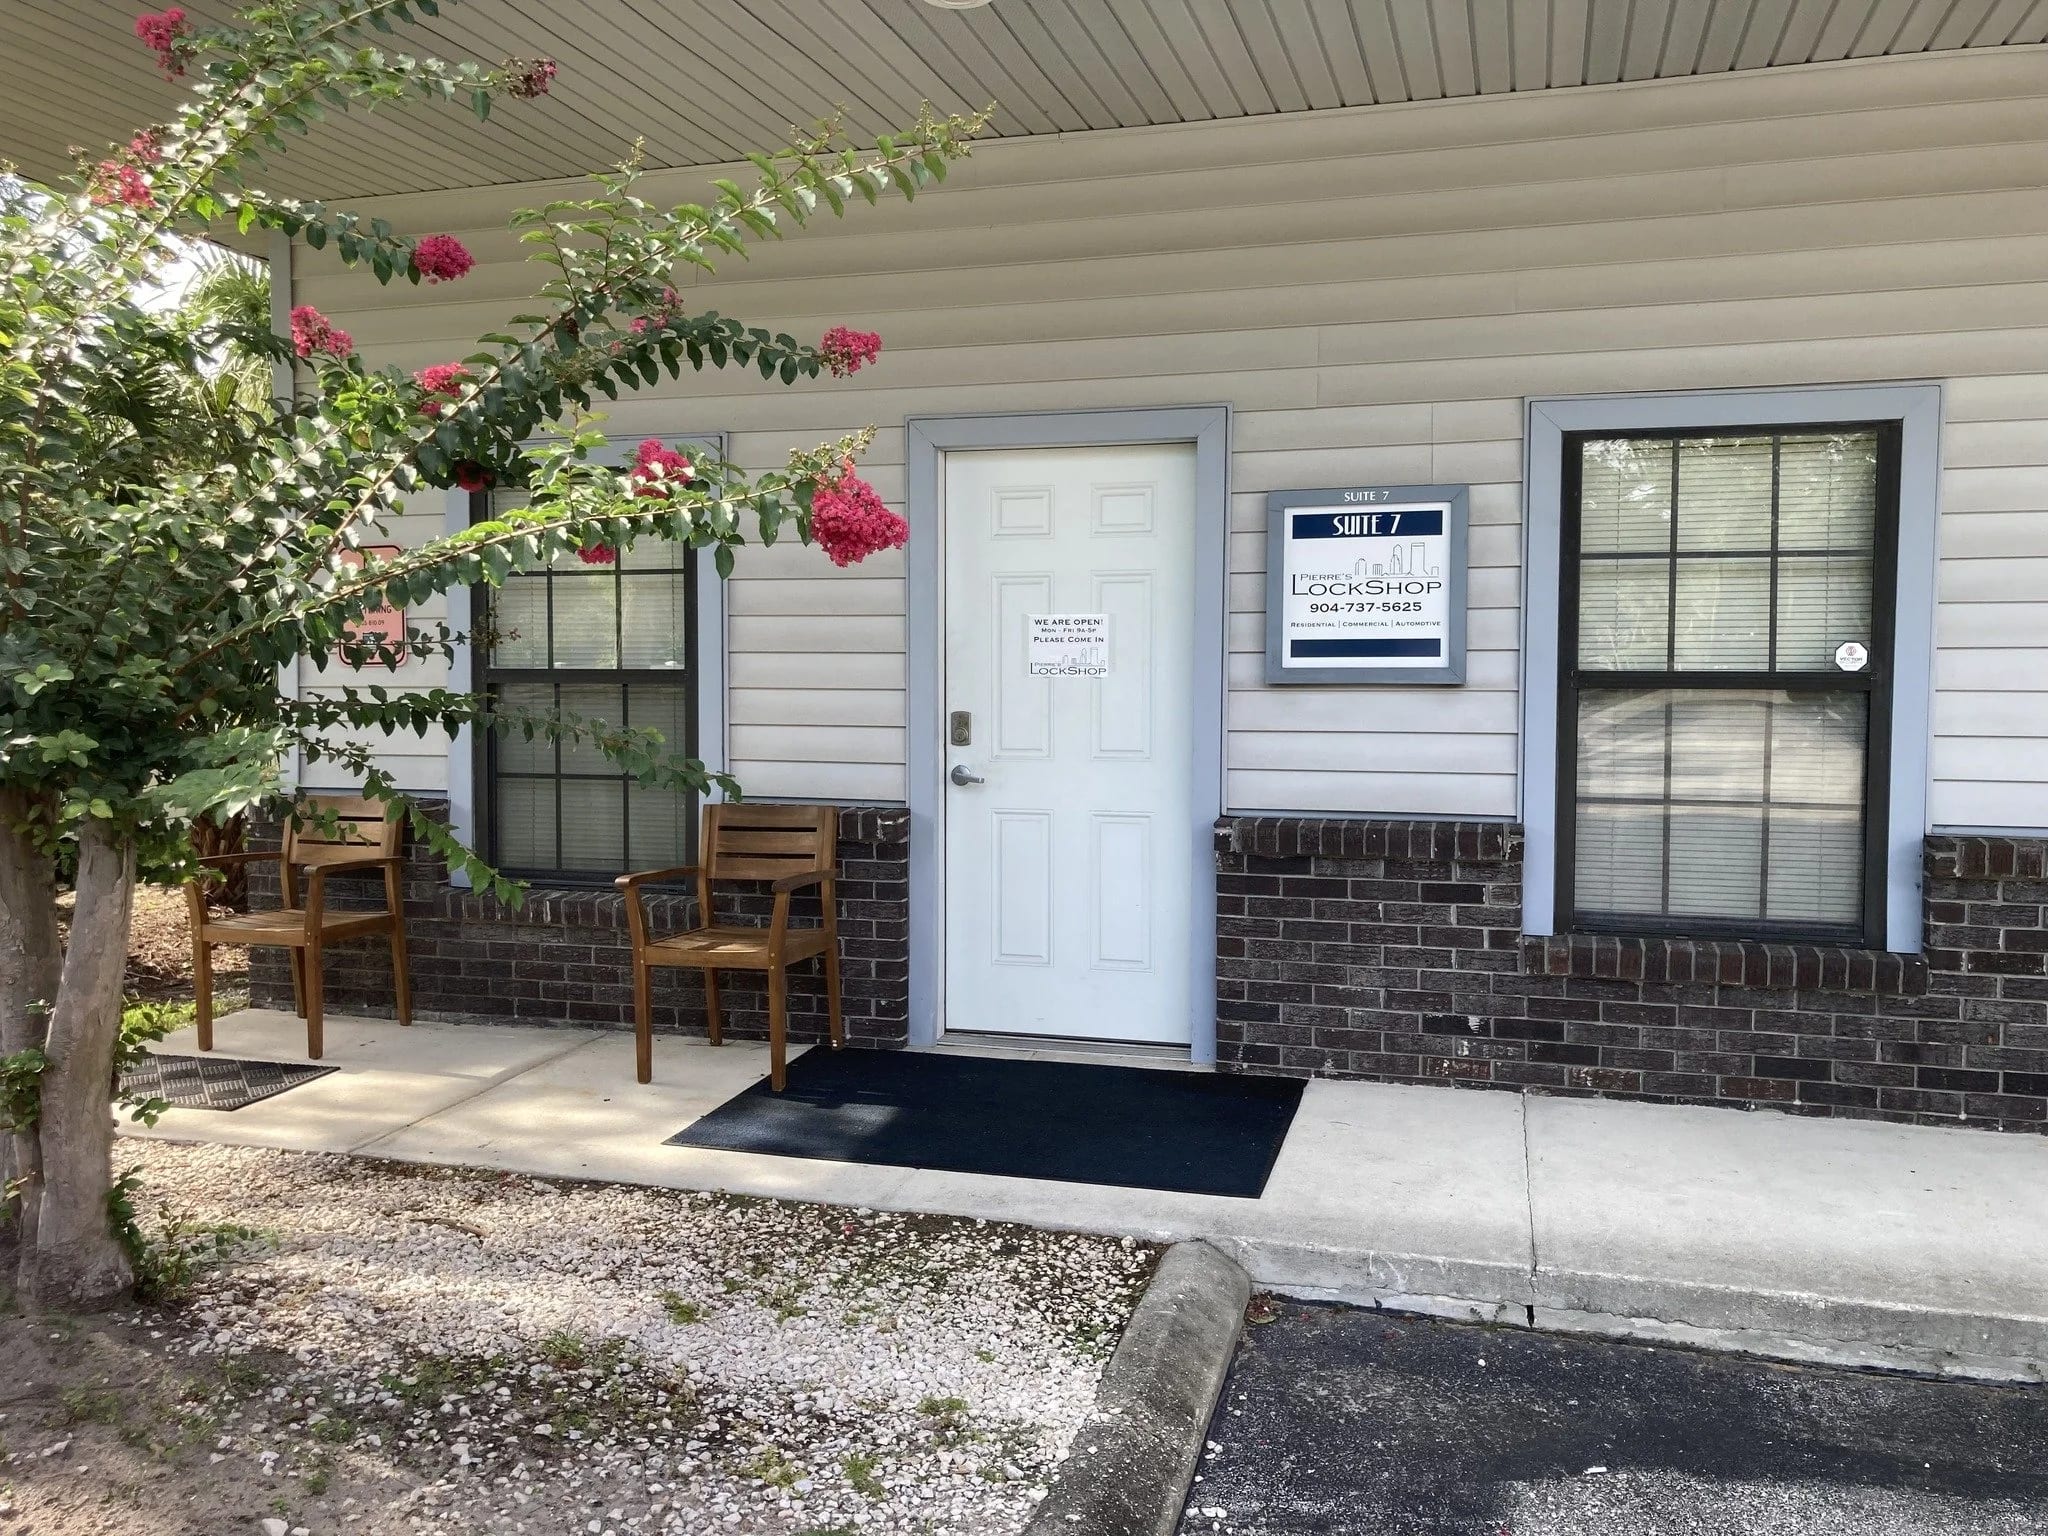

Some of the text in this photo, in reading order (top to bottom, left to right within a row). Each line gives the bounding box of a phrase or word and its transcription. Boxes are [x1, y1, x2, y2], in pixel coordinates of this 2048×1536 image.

[1344, 491, 1389, 502] SUITE 7
[1332, 514, 1401, 536] SUITE 7
[1300, 573, 1353, 581] PIERRE'S
[1292, 574, 1442, 596] LOCKSHOP
[1310, 602, 1422, 613] 904-737-5625
[1030, 663, 1107, 675] LOCKSHOP
